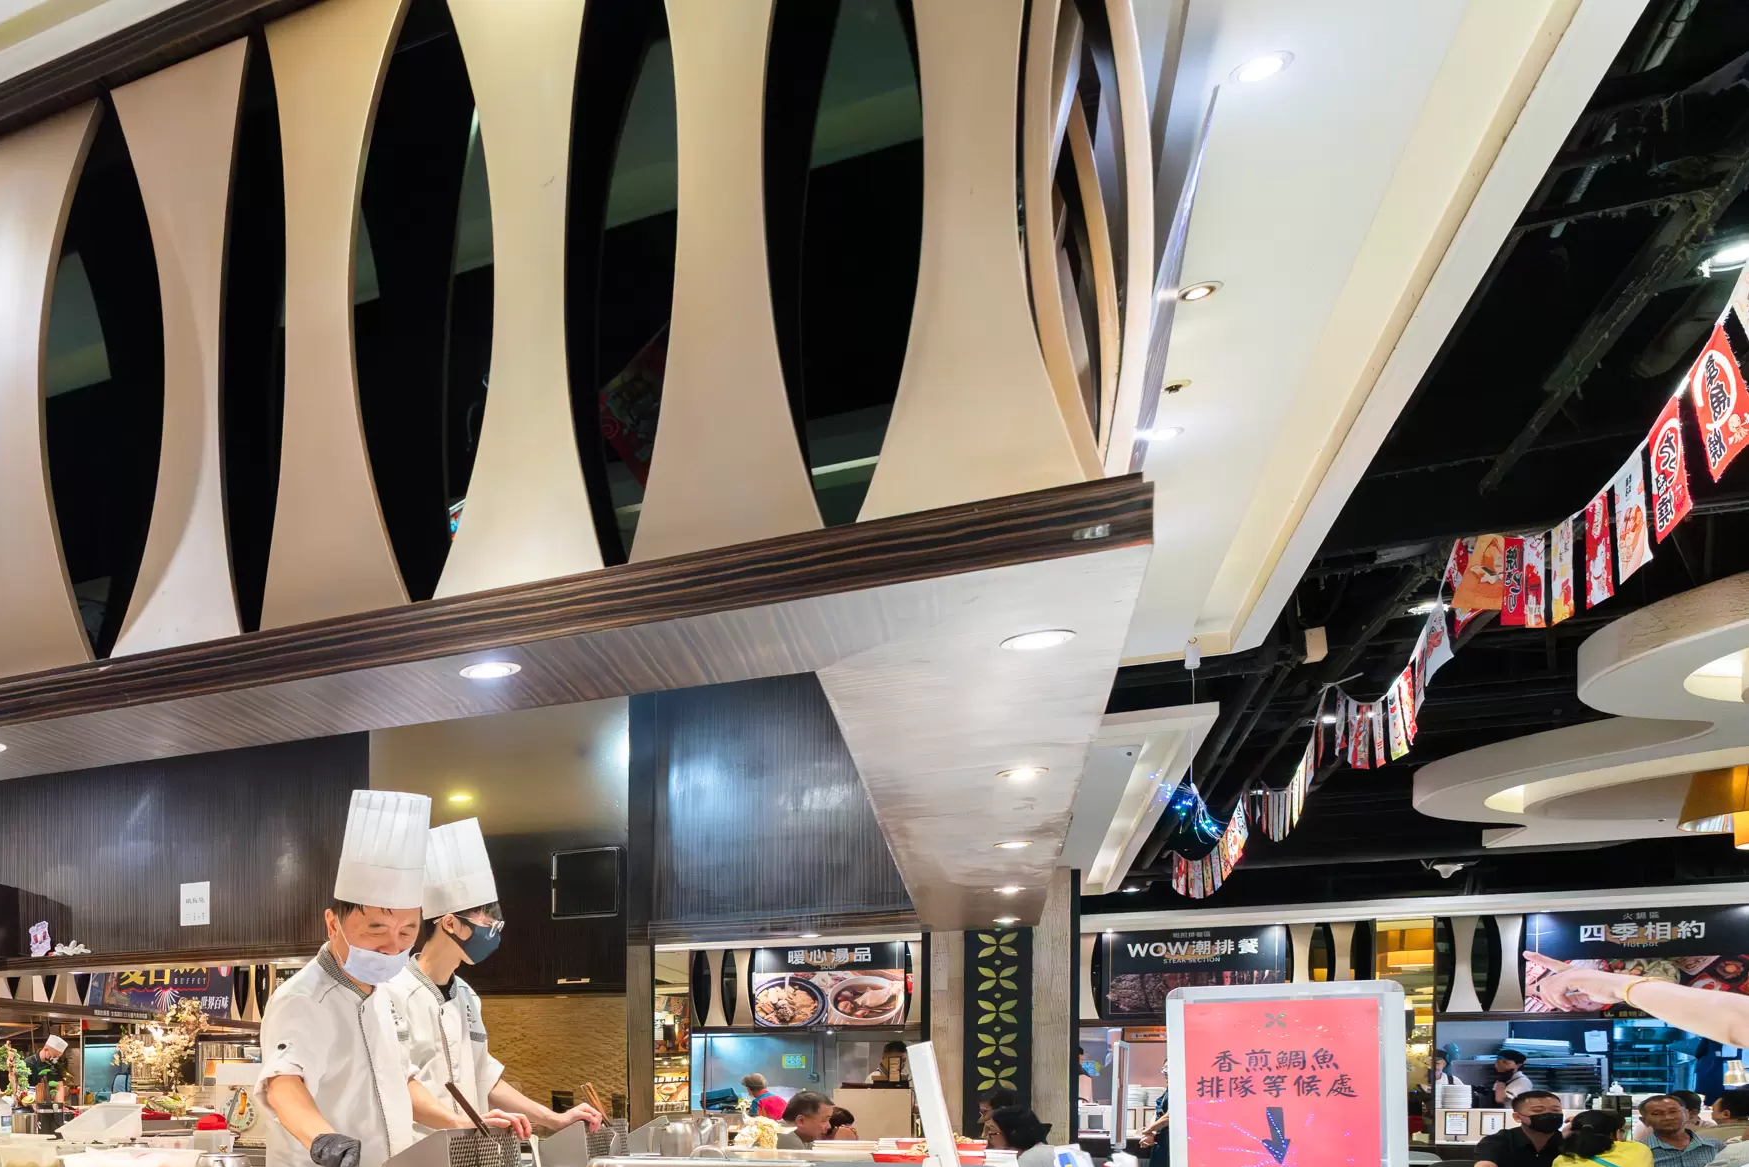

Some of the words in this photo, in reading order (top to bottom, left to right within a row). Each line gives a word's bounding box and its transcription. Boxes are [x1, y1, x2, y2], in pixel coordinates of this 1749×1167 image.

[1579, 920, 1706, 942] 四季相約
[788, 947, 872, 965] 暖心湯品
[1126, 938, 1259, 958] WOW潮排餐
[173, 977, 207, 985] BUFFET
[1210, 1047, 1340, 1073] 香煎鯛魚
[1195, 1074, 1359, 1099] 排隊等候處
